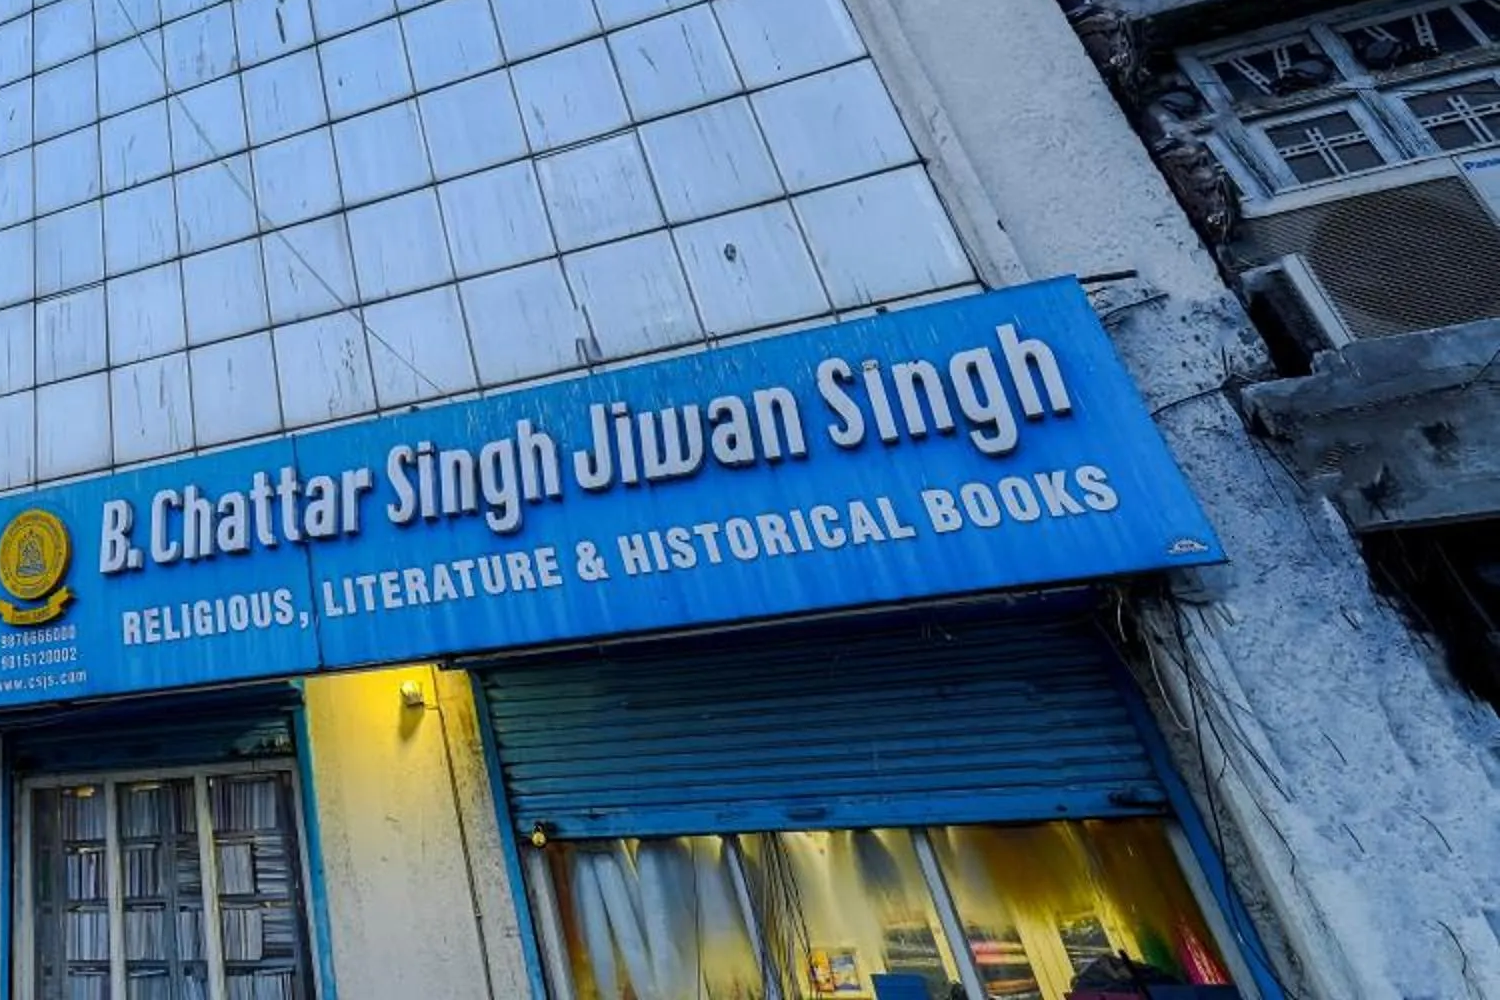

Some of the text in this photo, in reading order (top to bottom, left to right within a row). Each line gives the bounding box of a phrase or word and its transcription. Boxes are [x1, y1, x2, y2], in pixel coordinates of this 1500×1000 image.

[100, 500, 143, 573] B.
[150, 464, 373, 564] Chattar
[386, 419, 563, 534] Singh
[573, 385, 807, 491] Jiwan
[816, 323, 1073, 456] Singh
[123, 465, 1120, 645] RELIGIOUS, LITERATURE & HISTORICAL BOOKS
